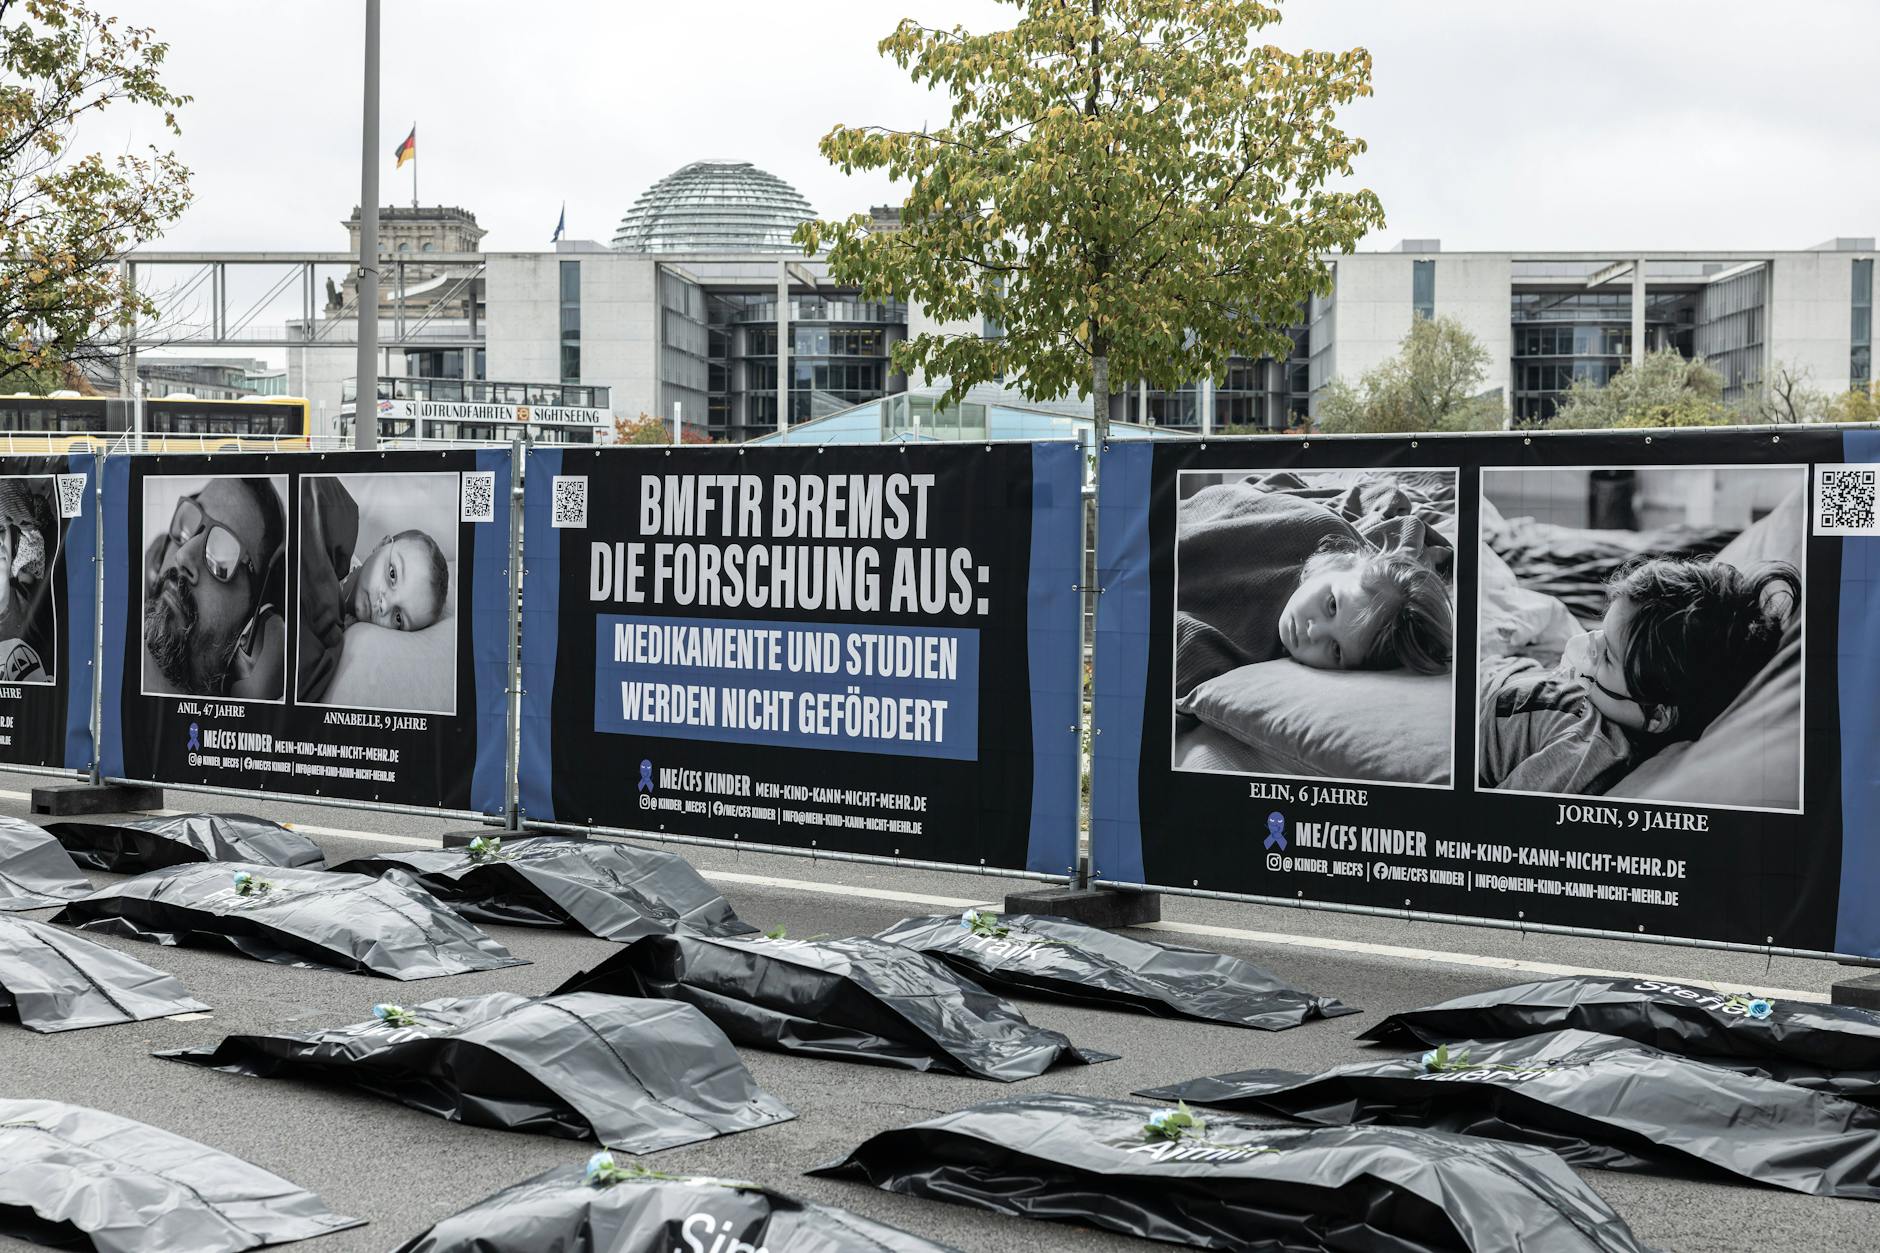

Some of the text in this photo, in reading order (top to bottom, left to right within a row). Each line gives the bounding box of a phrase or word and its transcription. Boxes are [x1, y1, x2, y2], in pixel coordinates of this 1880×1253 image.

[534, 407, 600, 423] SIGHTSEEING
[639, 473, 935, 540] BMFTR BREMST
[589, 541, 990, 615] DIE FORSCHUNG AUS:
[614, 623, 958, 680] MEDIKAMENTE UND STUDIEN
[177, 702, 245, 718] ANIL, 47 JAHRE
[323, 712, 427, 731] ANNABELLE, 9 JAHRE
[621, 681, 948, 743] WERDEN NICHT GEFÖRDERT
[203, 729, 399, 763] ME/CFS KINDER MEIN-KIND-KANN-NICHT-MEHR.DE
[659, 767, 928, 812] ME/CFS KINDER MEIN-KIND-KANN-NICHT-MEHR.DE
[1250, 783, 1368, 807] ELIN, 6 JAHRE
[751, 806, 777, 821] KINDER
[782, 810, 923, 835] INFO@MEIN-KIND-KANN-NICHT-MEHR.DE
[1556, 803, 1709, 832] JORIN, 9 JAHRE
[1295, 821, 1687, 879] ME/CFS KINDER MEIN-KIND-KANN-NICHT-MEHR.DE
[1294, 857, 1363, 877] KINDER_MECFS
[1429, 869, 1464, 886] KINDER
[1475, 873, 1679, 906] INFO@MEIN-KIND-KANN-NICHT-MEHR.DE
